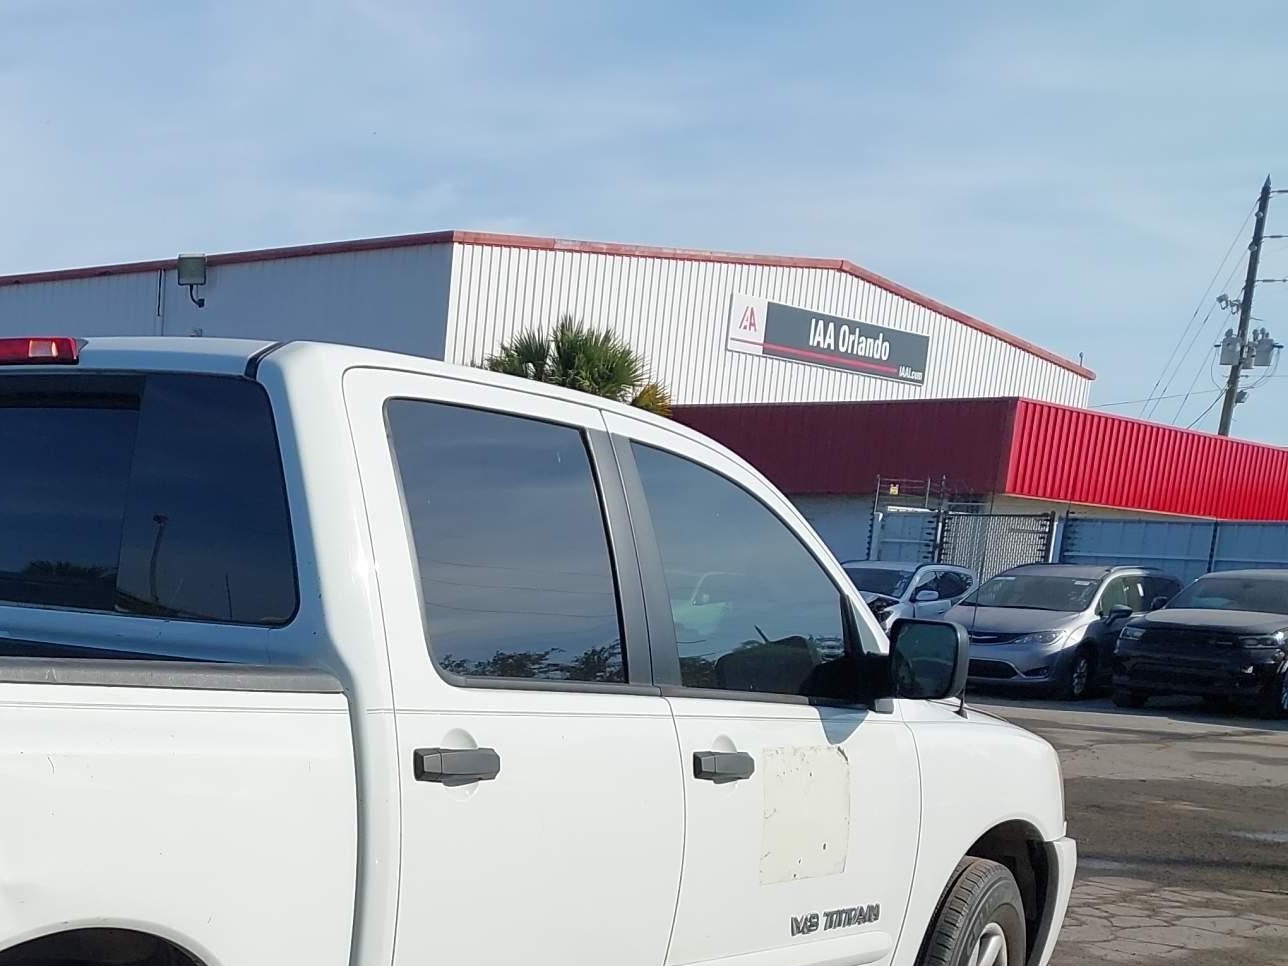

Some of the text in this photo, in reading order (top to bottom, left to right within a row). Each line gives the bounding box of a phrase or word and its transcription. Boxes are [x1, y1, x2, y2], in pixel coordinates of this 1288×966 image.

[809, 318, 890, 361] IAA Orlando
[791, 903, 880, 936] V8 TITAN
